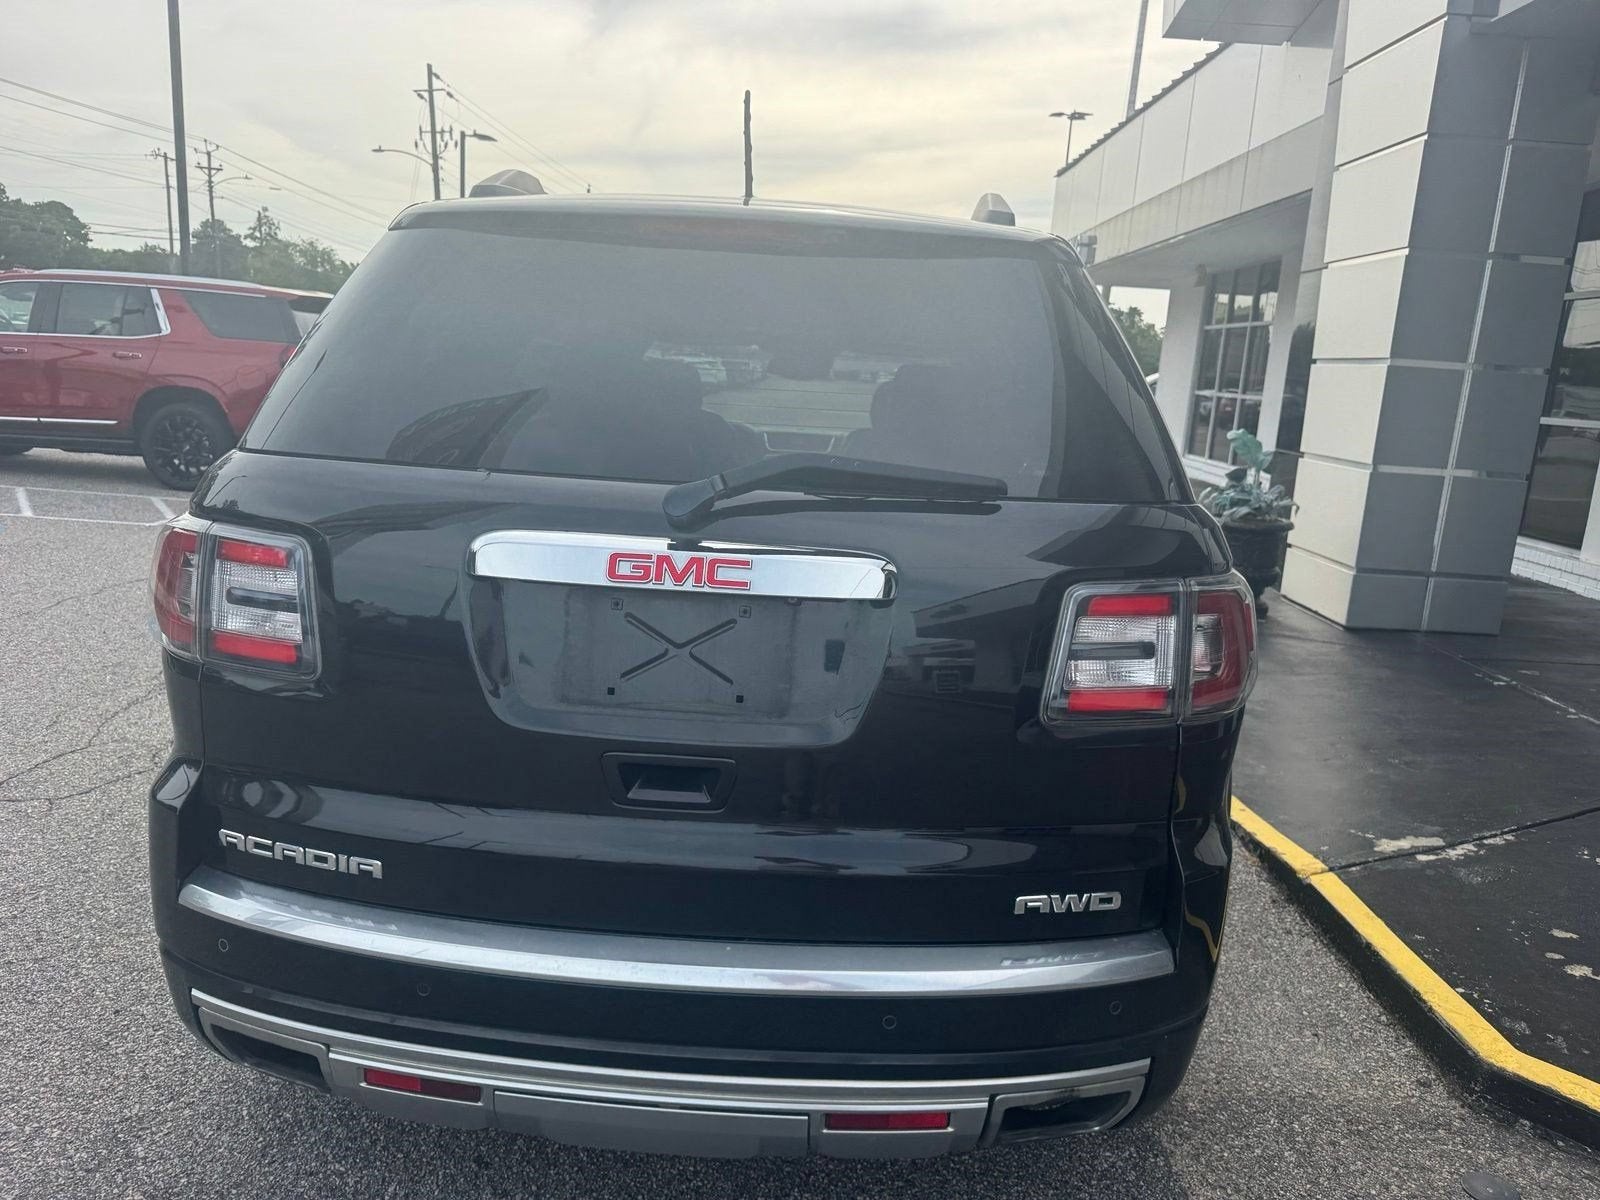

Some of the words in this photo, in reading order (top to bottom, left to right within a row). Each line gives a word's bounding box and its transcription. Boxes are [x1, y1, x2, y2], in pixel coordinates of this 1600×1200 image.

[606, 552, 752, 590] GMC
[218, 829, 383, 879] ACADIA
[1014, 891, 1122, 915] AWD
